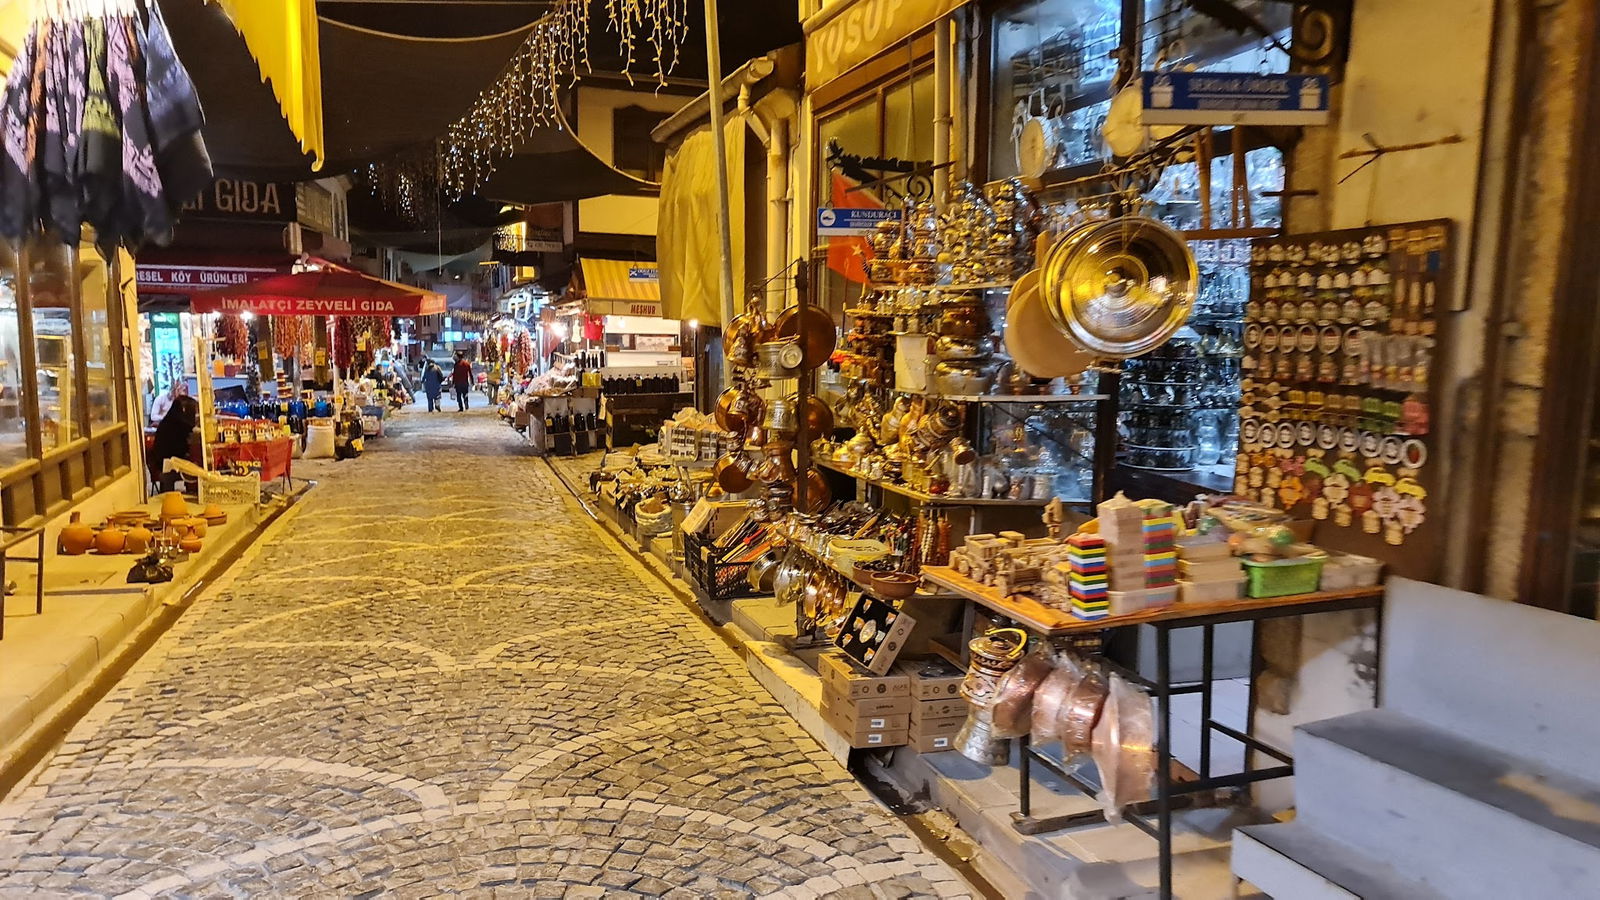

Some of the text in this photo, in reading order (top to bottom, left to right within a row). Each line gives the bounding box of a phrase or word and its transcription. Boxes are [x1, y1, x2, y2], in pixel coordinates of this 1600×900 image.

[216, 178, 281, 214] GIDA
[171, 270, 191, 283] KÖY
[200, 271, 248, 284] ÜRÜNLERİ
[221, 297, 394, 312] İMALATÇI ZEYVELİ GIDA
